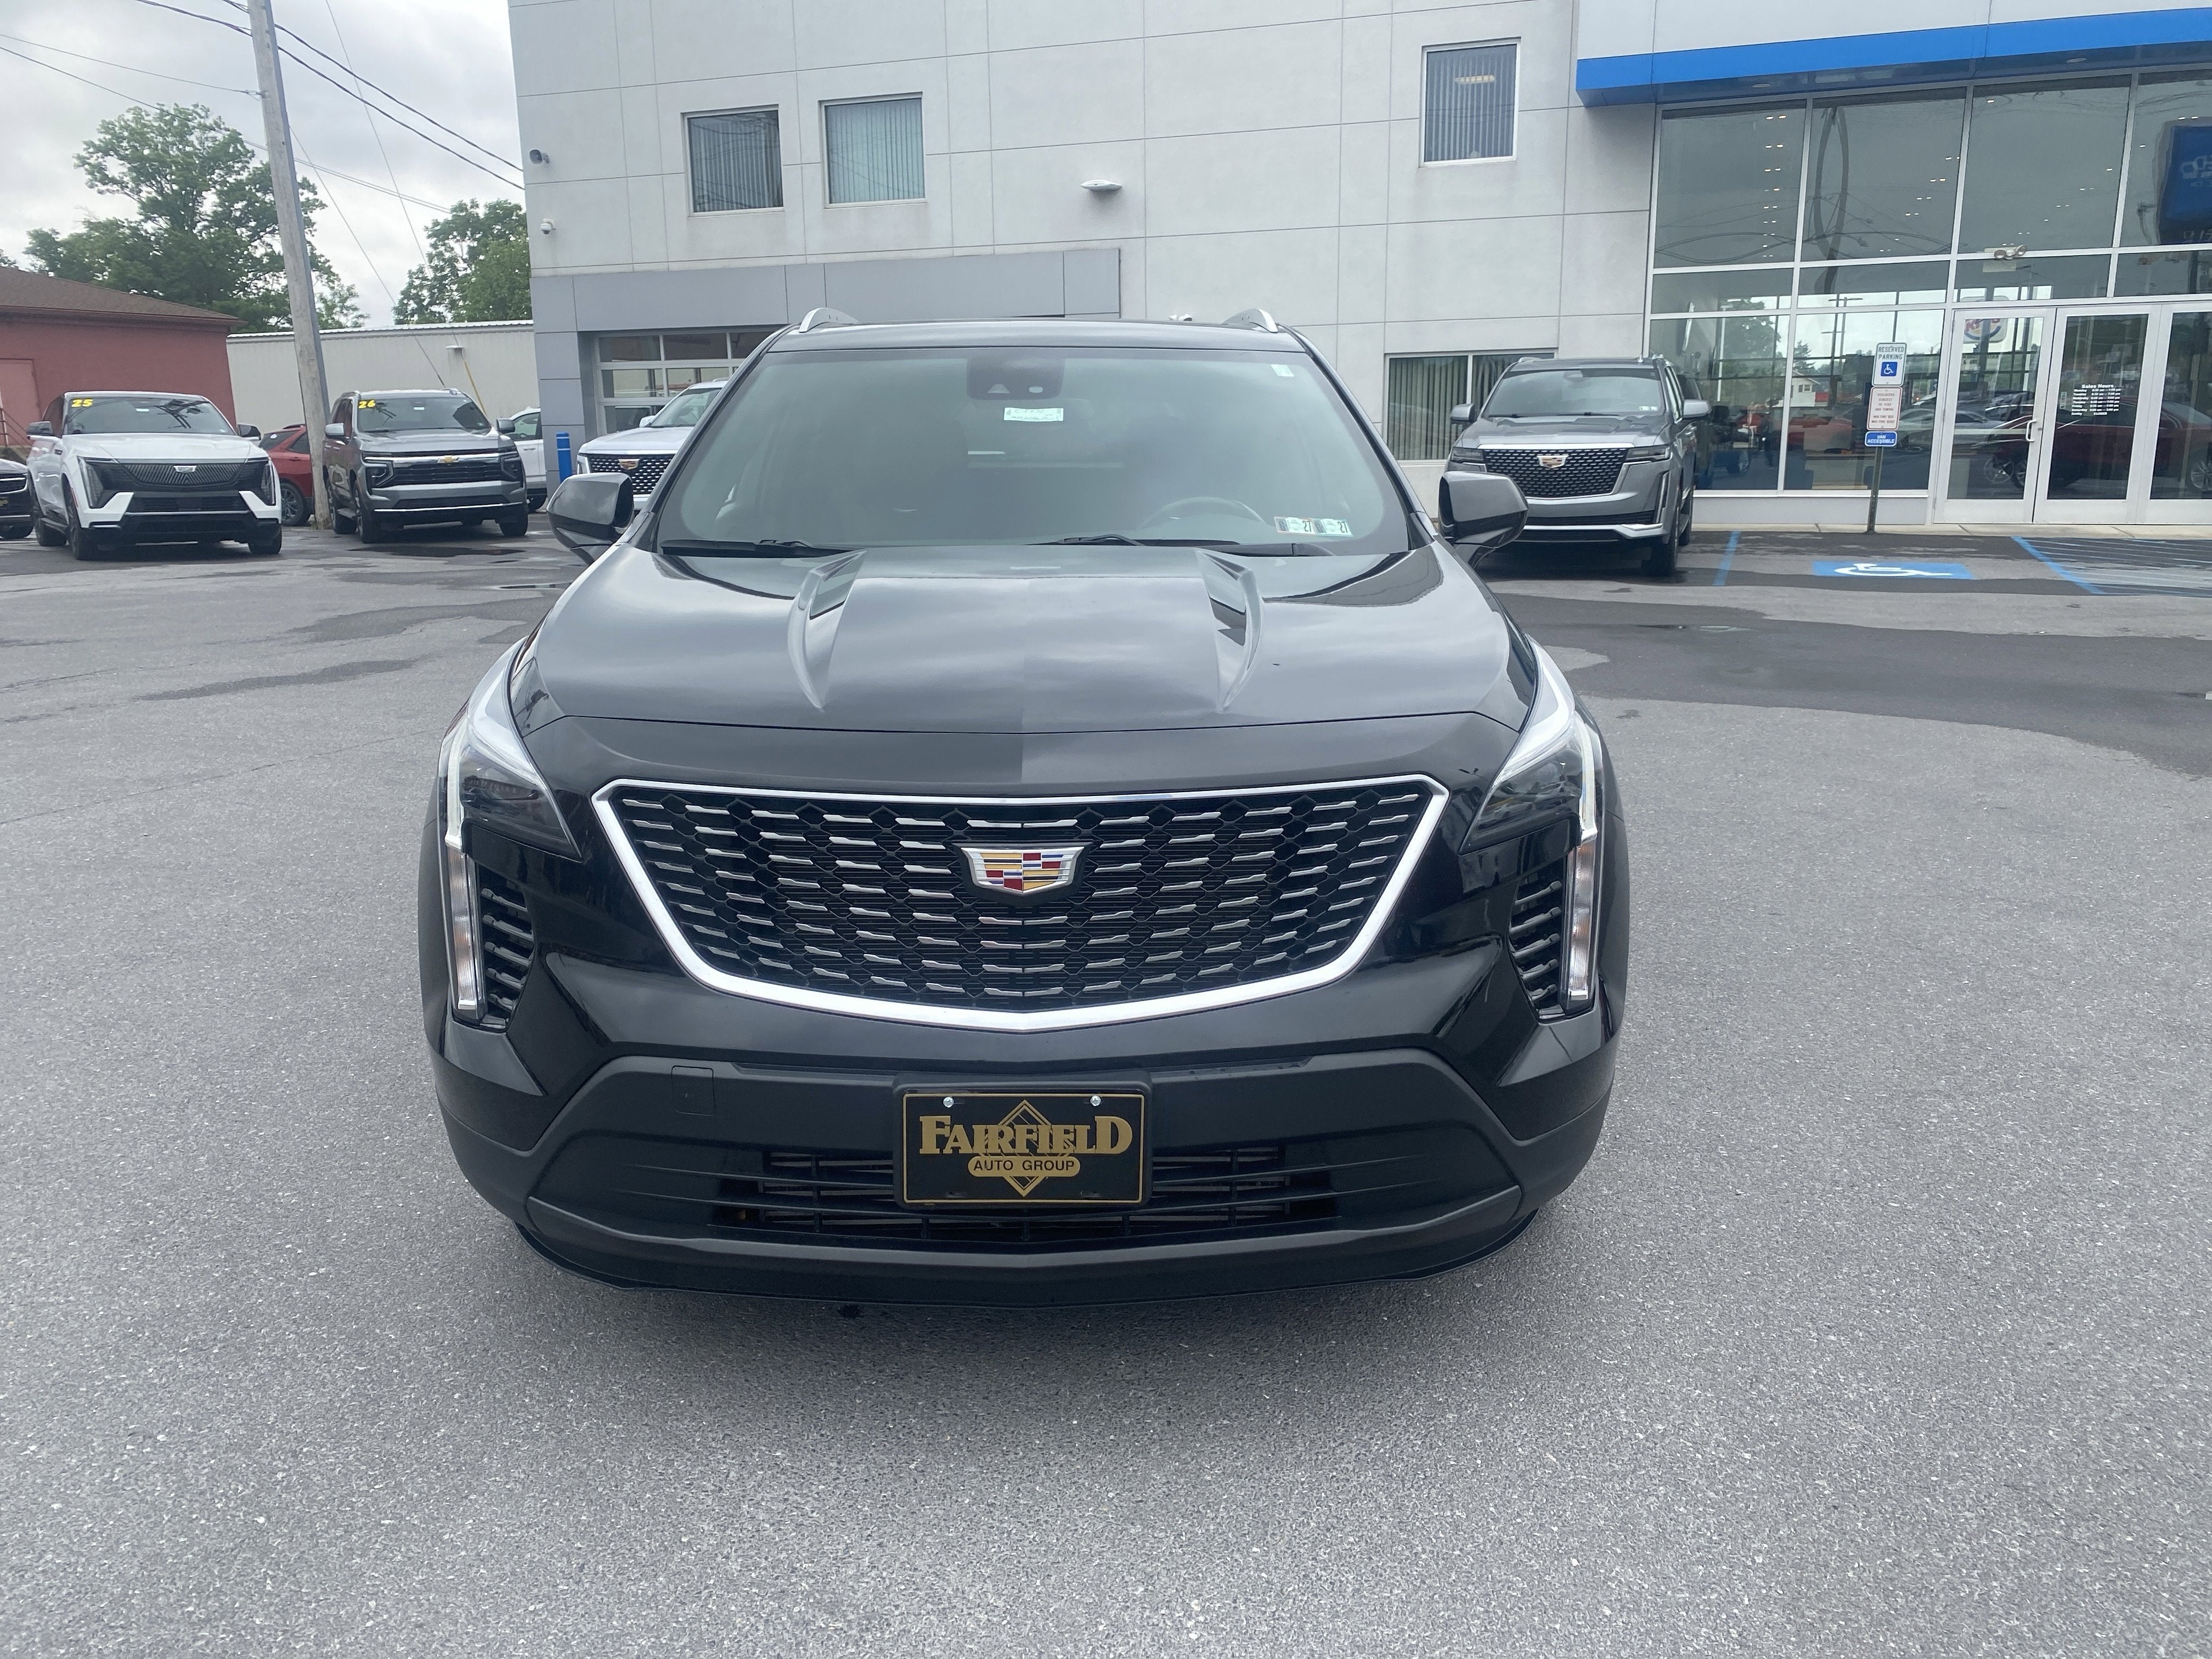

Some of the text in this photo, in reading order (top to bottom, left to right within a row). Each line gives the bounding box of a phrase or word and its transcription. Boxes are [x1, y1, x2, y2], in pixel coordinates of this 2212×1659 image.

[71, 399, 93, 407] 25
[358, 399, 375, 409] 26
[1302, 520, 1312, 533] 27
[1337, 521, 1348, 533] 27
[919, 1115, 1133, 1154] FAIRFIELD
[973, 1160, 1075, 1171] AUTO GROUP
